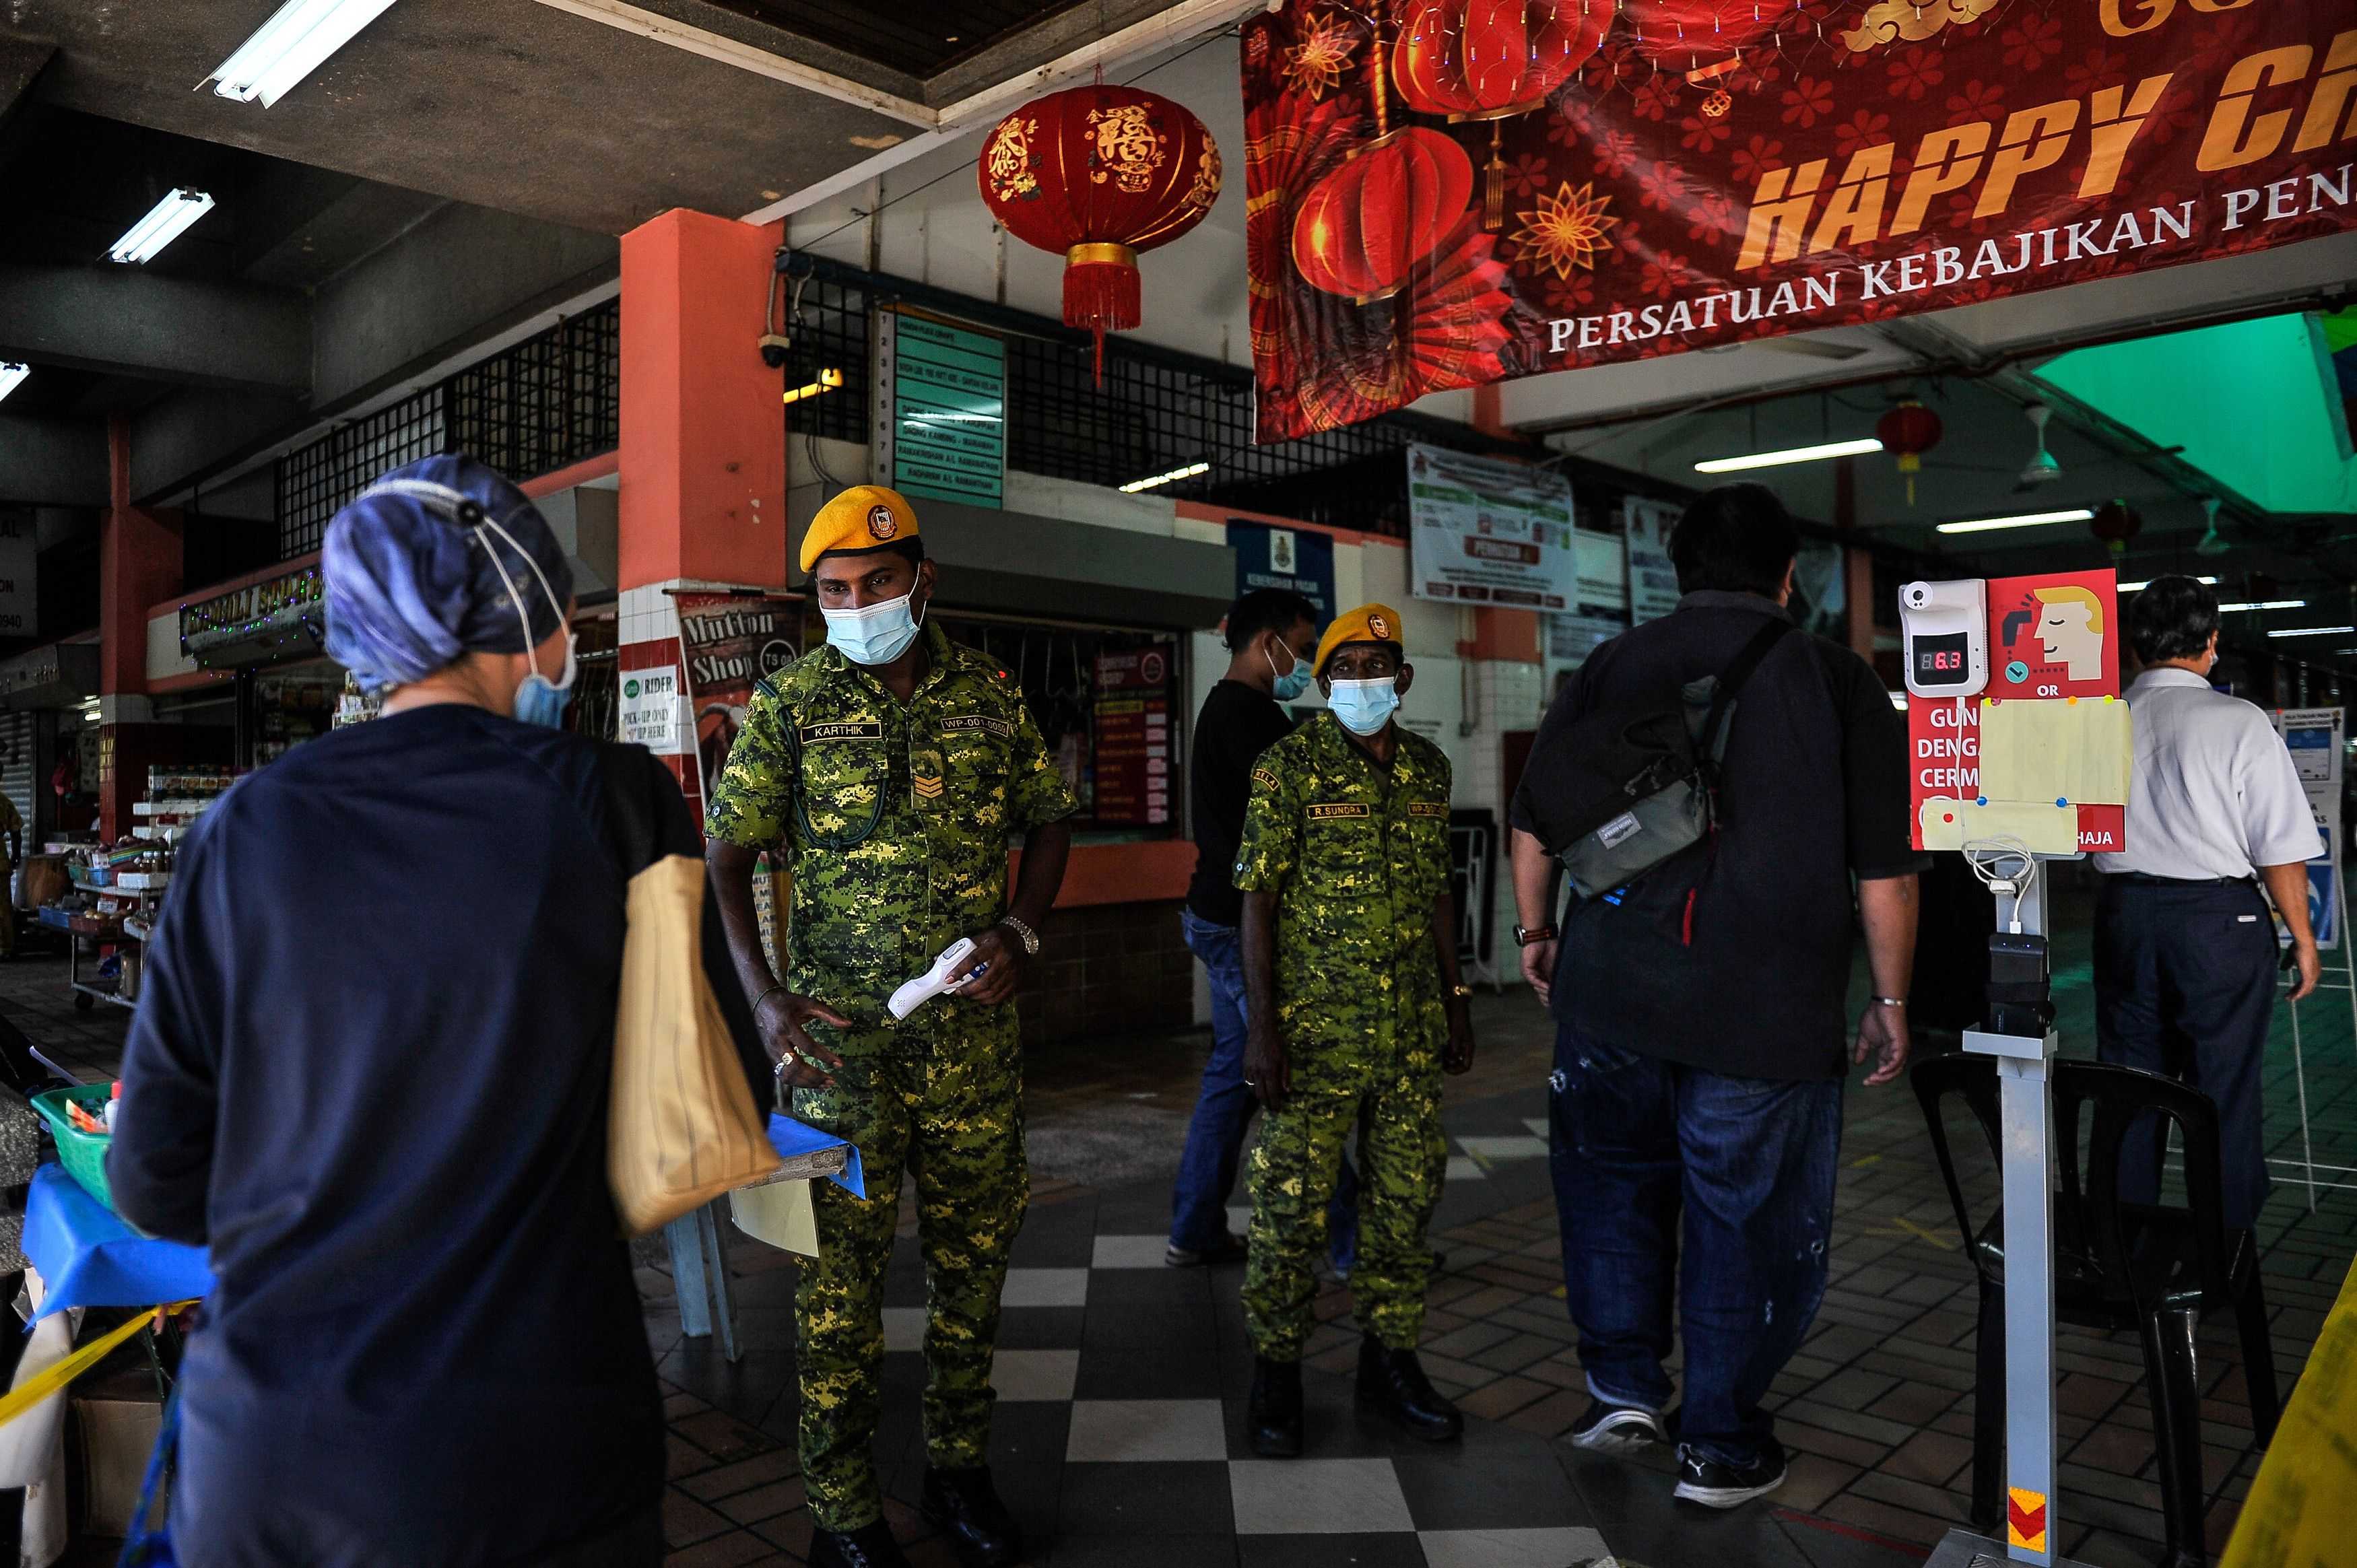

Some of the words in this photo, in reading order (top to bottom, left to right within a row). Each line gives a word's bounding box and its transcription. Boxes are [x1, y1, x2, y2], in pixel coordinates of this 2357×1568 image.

[1735, 73, 2175, 271] HAPPY
[1548, 271, 1837, 354] PERSATUAN
[1859, 201, 2195, 300] KEBAJIKAN
[2222, 164, 2357, 231] PEN
[685, 612, 774, 644] Mutton
[694, 655, 754, 685] Shop
[765, 653, 778, 667] TS
[644, 677, 672, 695] RIDER
[2036, 685, 2059, 697] OR
[1930, 708, 1981, 727] GUN
[647, 725, 665, 739] HERE
[815, 726, 864, 737] KARTHIK
[1917, 738, 1981, 758] DENG
[1255, 771, 1275, 786] RELA
